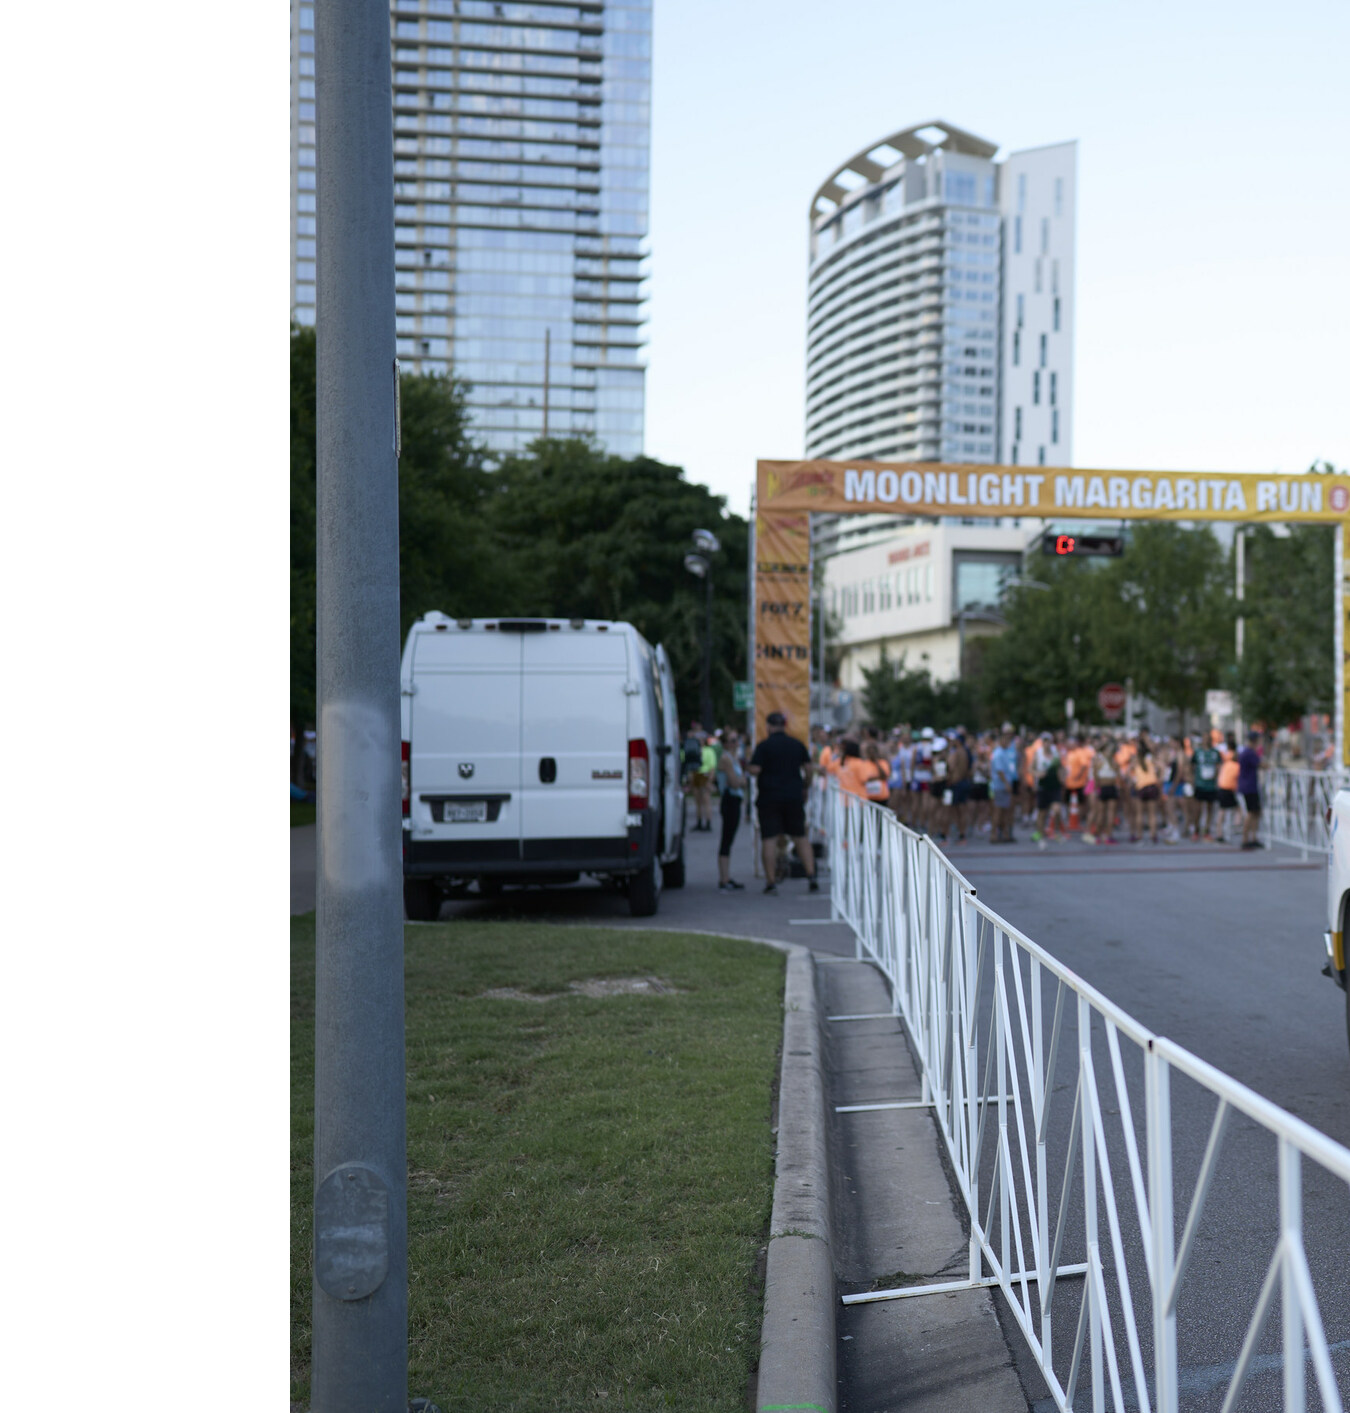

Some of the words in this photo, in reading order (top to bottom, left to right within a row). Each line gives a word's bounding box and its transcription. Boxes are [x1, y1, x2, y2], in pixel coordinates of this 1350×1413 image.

[844, 469, 1045, 507] MOONLIGHT
[1053, 475, 1248, 511] MARGARITA
[1255, 481, 1323, 513] RUN
